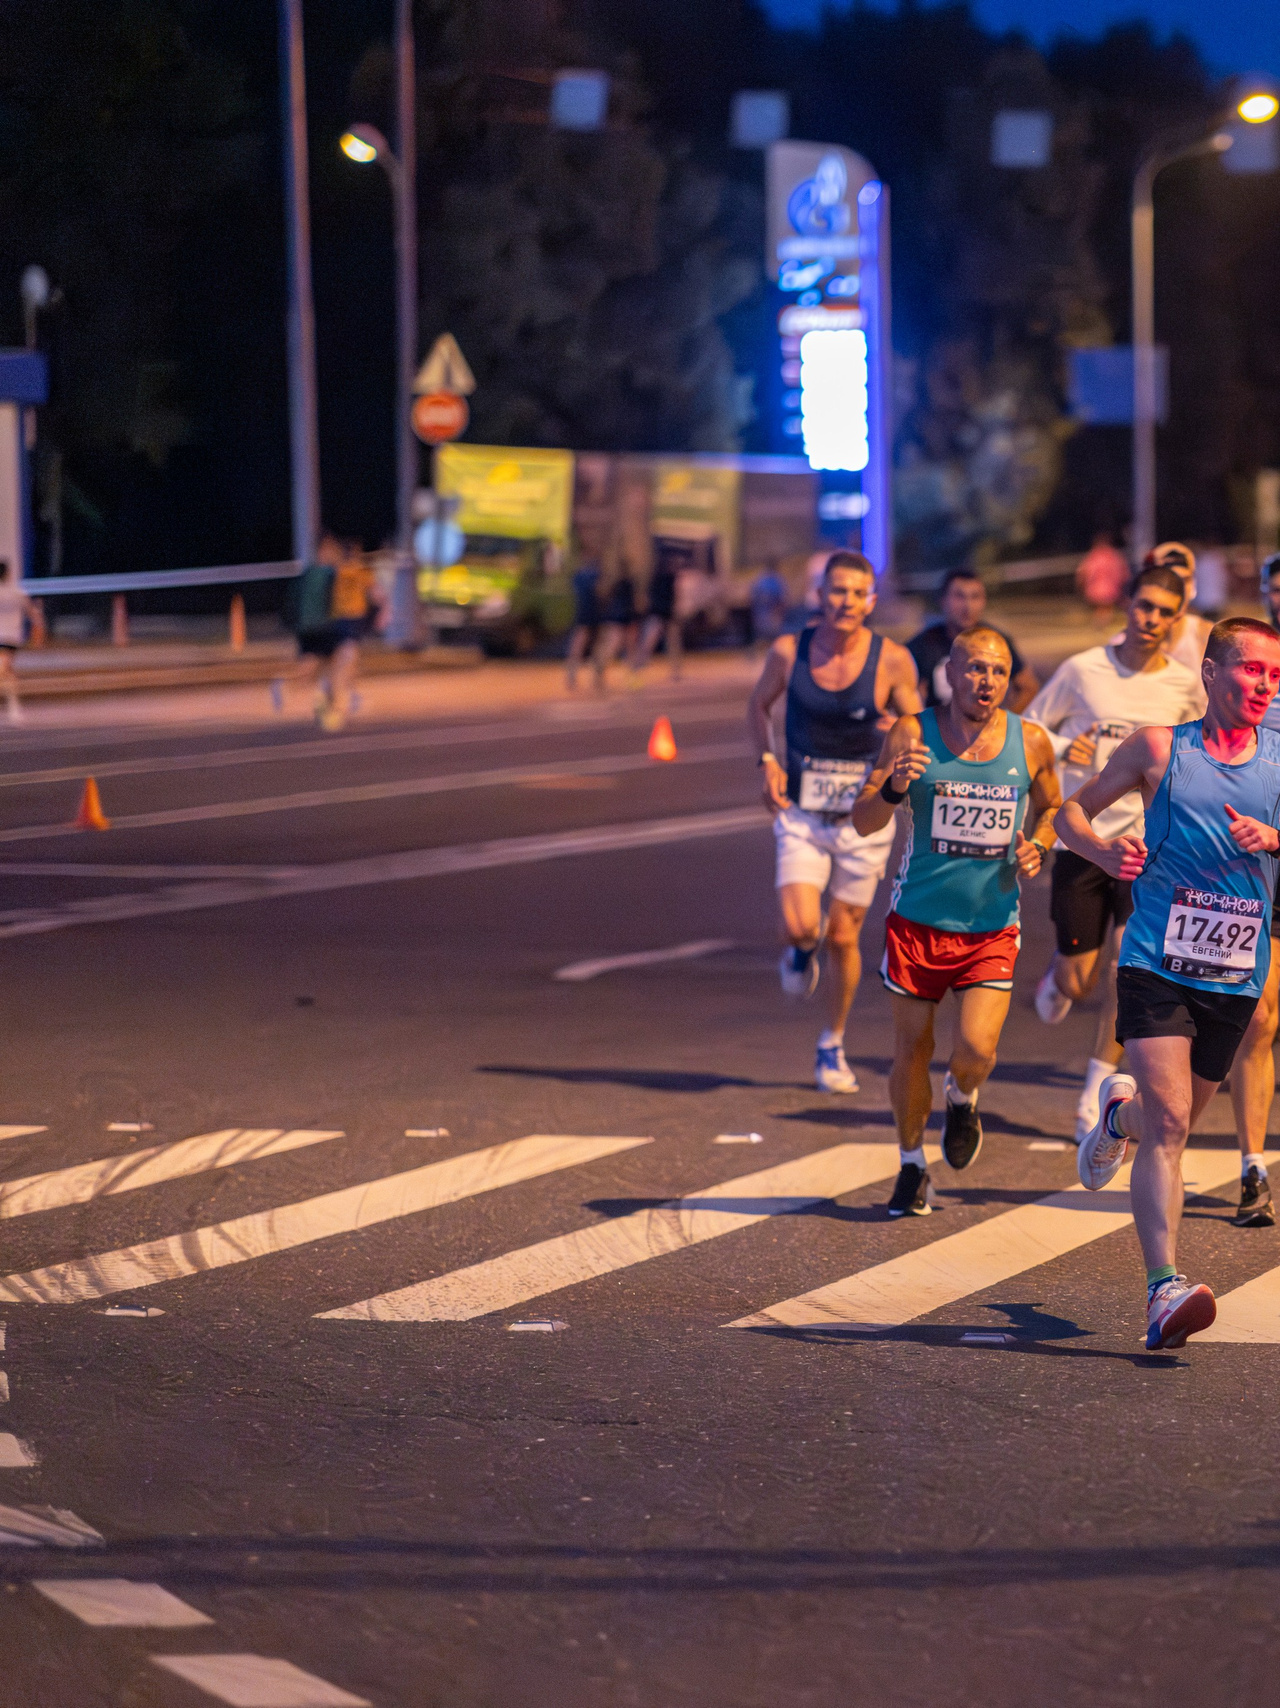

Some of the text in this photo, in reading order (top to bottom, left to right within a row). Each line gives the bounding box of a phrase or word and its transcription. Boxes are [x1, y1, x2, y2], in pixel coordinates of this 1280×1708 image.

[945, 781, 1012, 799] НОЧНОЙ
[939, 803, 1012, 830] 12735
[1185, 889, 1259, 914] НОЧНОЙ
[1174, 914, 1256, 952] 17492
[1191, 945, 1232, 959] ЕВГЕНИЙ
